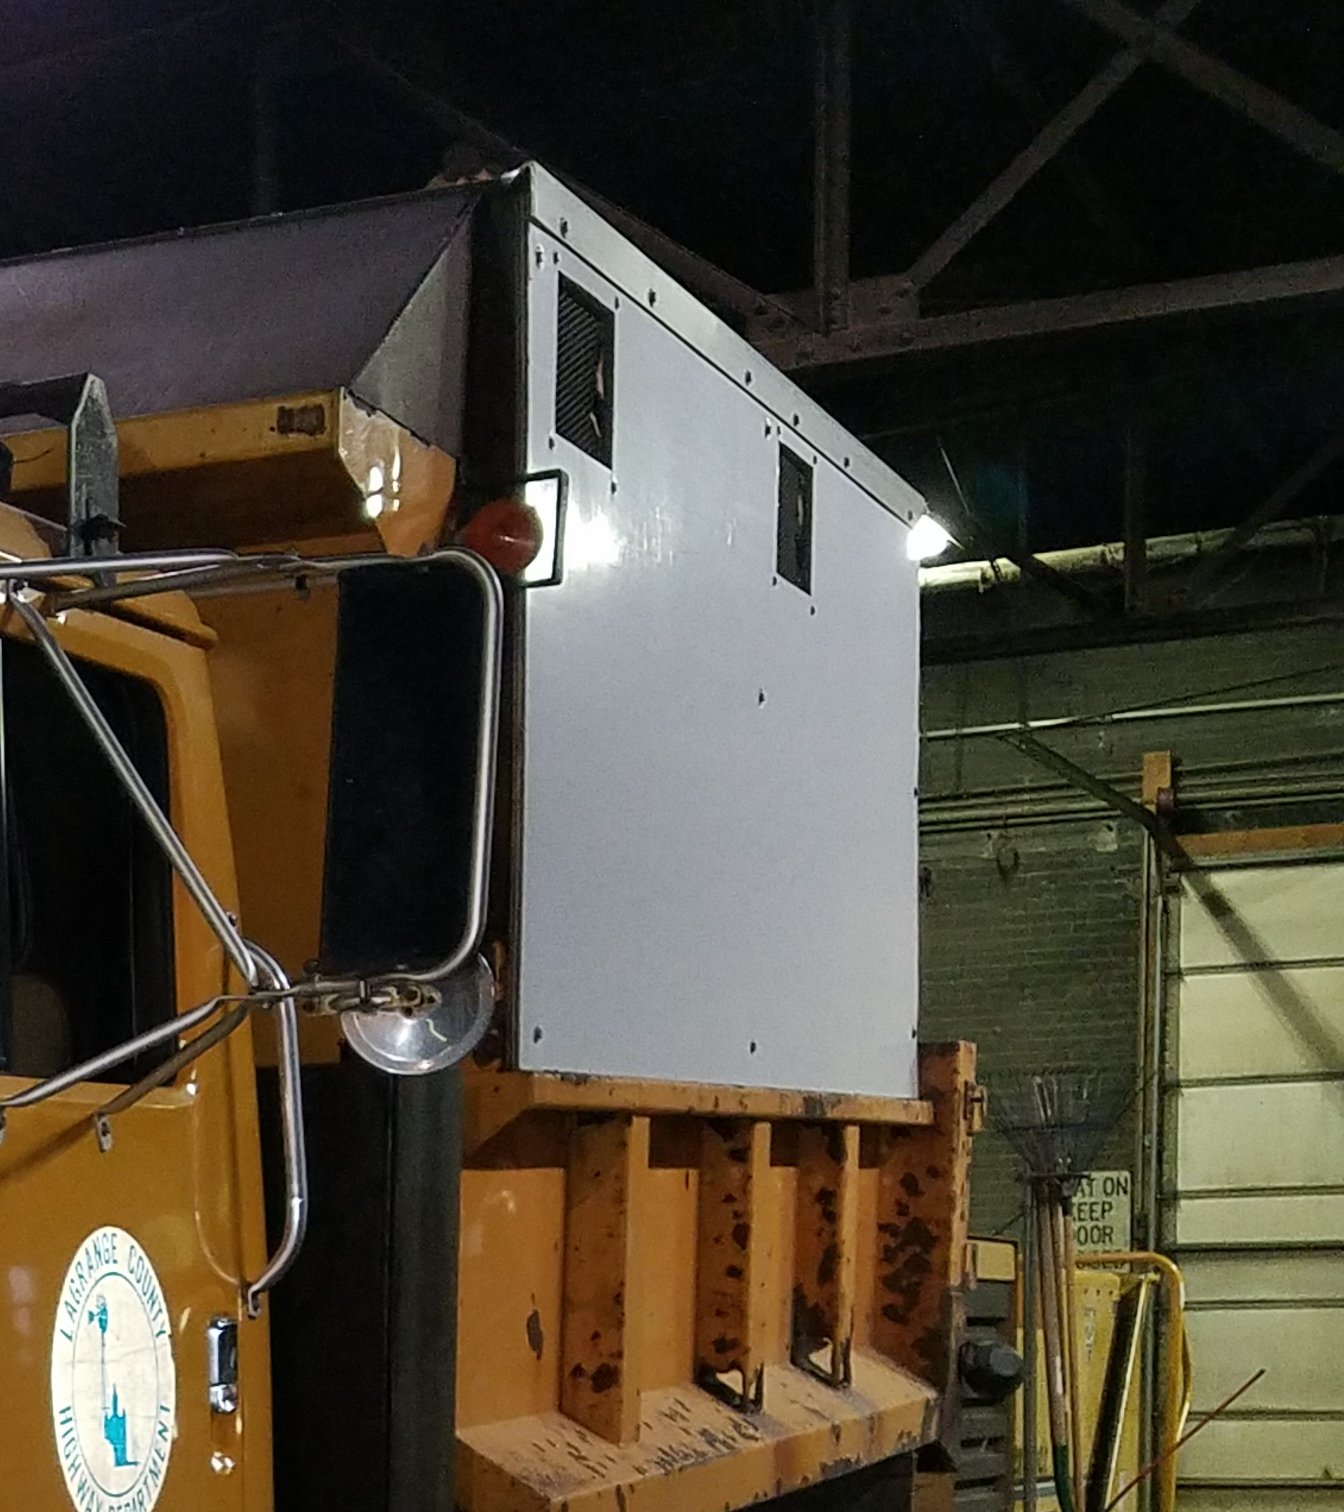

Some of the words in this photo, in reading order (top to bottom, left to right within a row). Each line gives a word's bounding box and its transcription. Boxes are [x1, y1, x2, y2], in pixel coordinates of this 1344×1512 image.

[1103, 1176, 1129, 1196] ON
[1072, 1201, 1113, 1221] EEP
[1074, 1225, 1114, 1245] OOR
[60, 1232, 118, 1342] LAGRANGE
[128, 1245, 167, 1338] COUNTY
